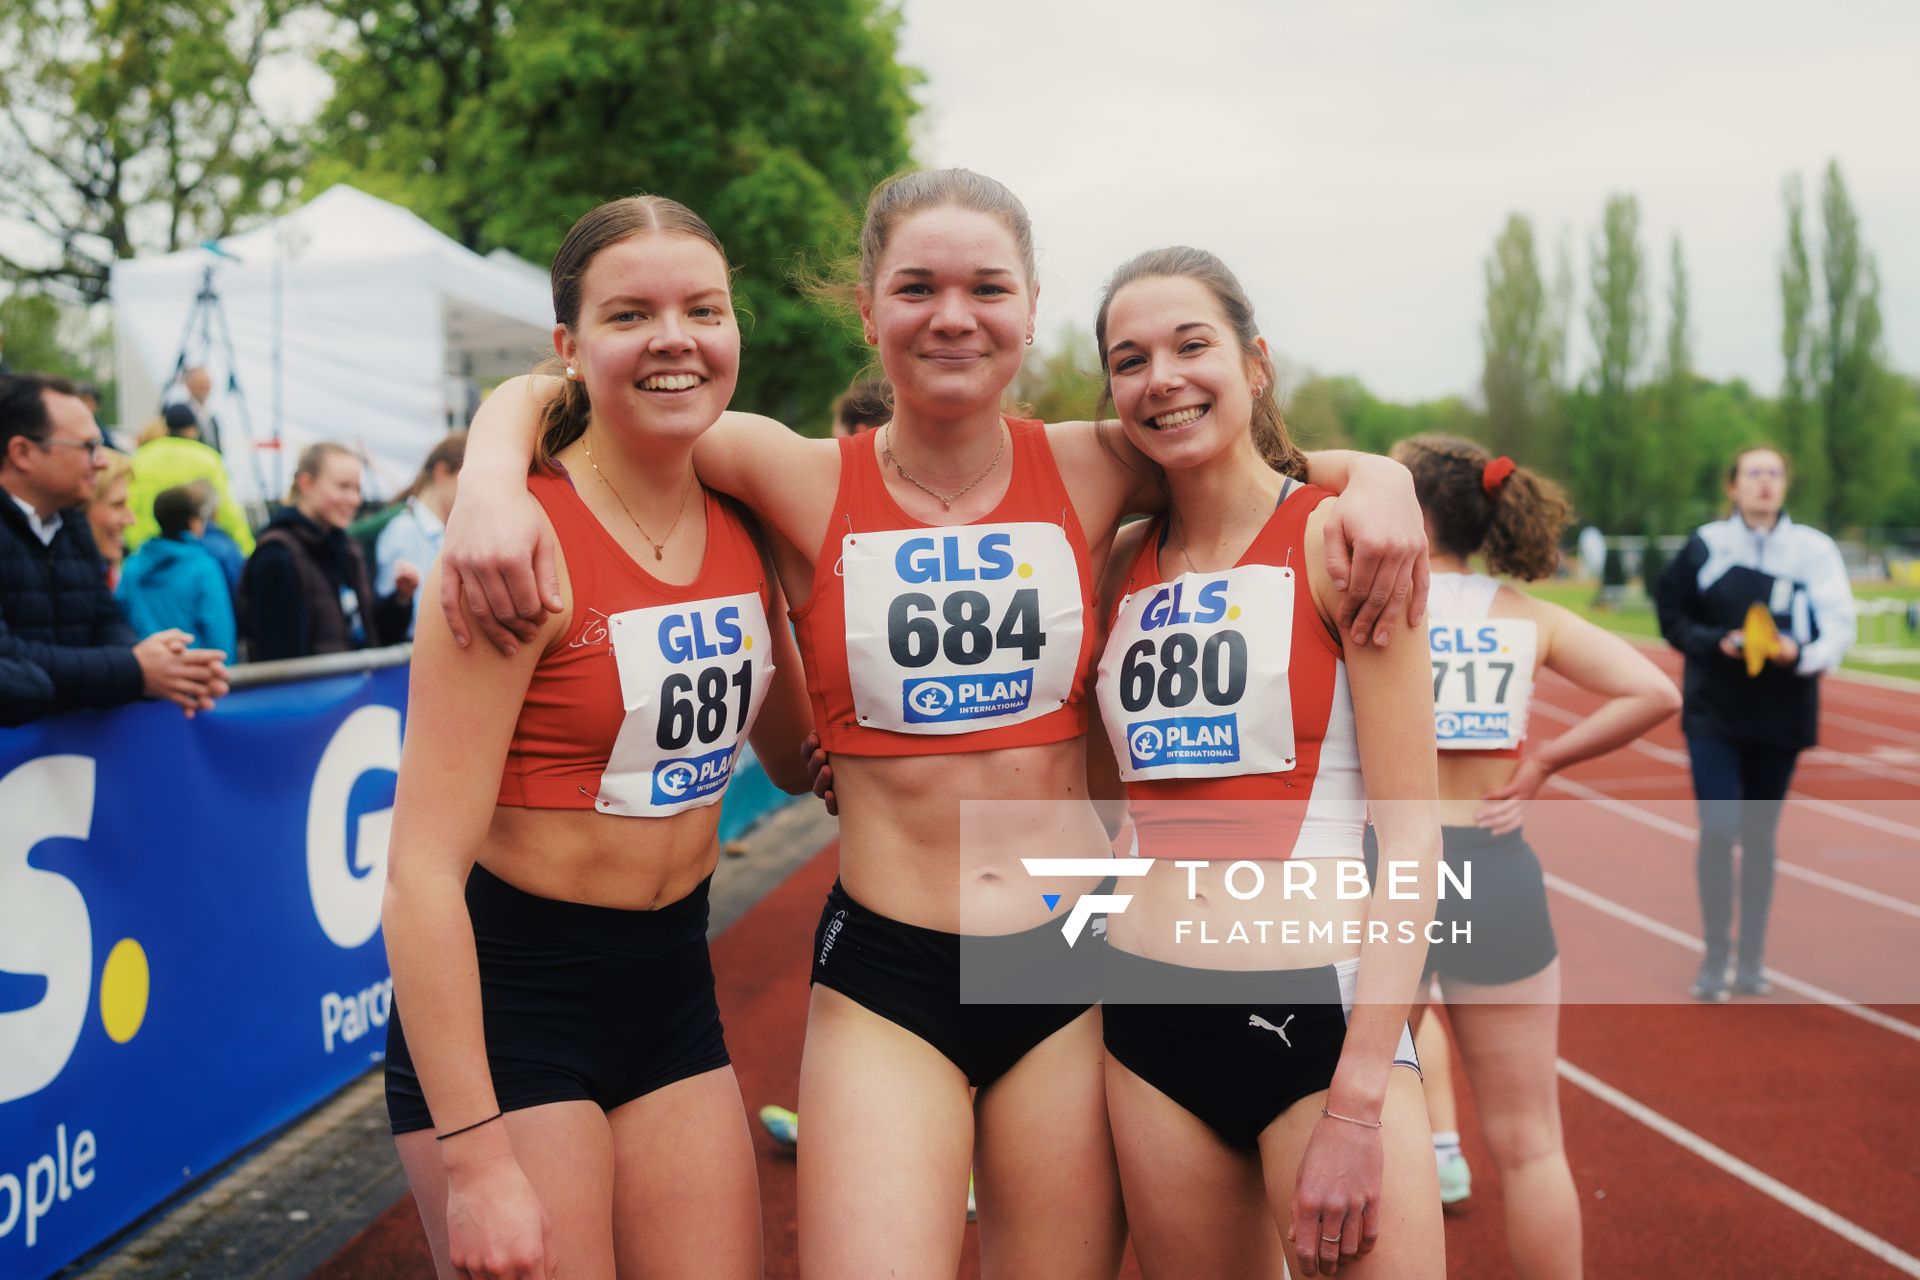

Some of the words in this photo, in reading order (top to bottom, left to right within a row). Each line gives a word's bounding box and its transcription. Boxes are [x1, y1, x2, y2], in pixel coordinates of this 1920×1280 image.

[895, 533, 1033, 584] GLS.
[888, 588, 1046, 667] 684
[1140, 580, 1241, 631] GLS.
[657, 606, 753, 664] GLS.
[958, 680, 1027, 703] PLAN
[1119, 630, 1247, 712] 680
[1432, 661, 1514, 704] 717
[656, 659, 752, 750] 681
[959, 701, 1025, 714] INTERNATIONAL
[1166, 725, 1232, 747] PLAN
[1166, 749, 1234, 758] INTERNATIONAL
[820, 919, 843, 966] Brillux
